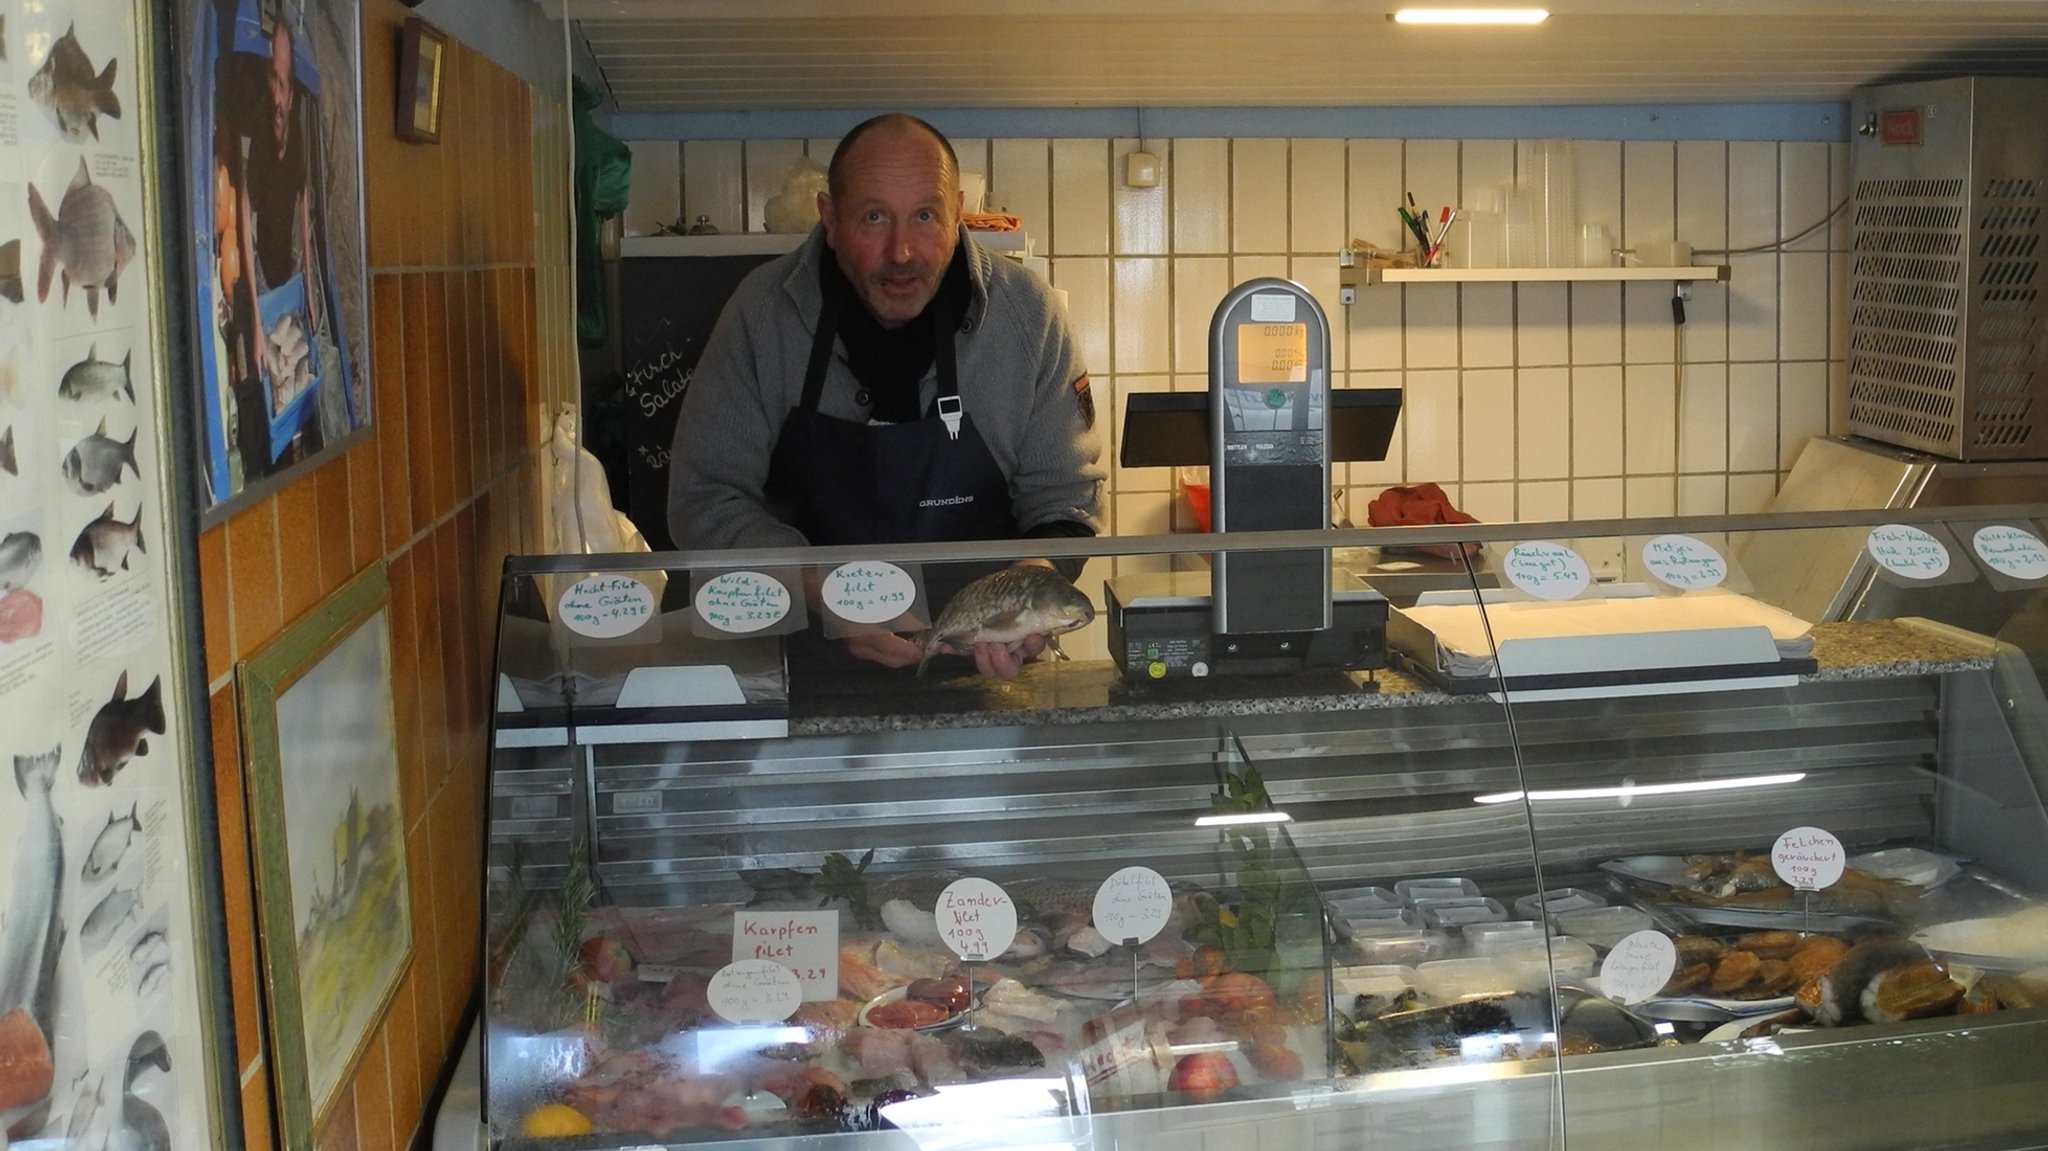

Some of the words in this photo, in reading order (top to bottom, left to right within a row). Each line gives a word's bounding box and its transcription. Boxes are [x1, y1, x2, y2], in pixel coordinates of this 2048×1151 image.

[836, 599, 864, 610] 100g
[573, 614, 600, 625] 100g
[1777, 851, 1837, 864] geräuchert
[1790, 865, 1817, 877] 100g
[953, 909, 980, 926] filet
[743, 919, 818, 940] Karpfen
[947, 928, 985, 941] 100g
[959, 940, 989, 953] 4.99
[791, 967, 828, 980] 3.29
